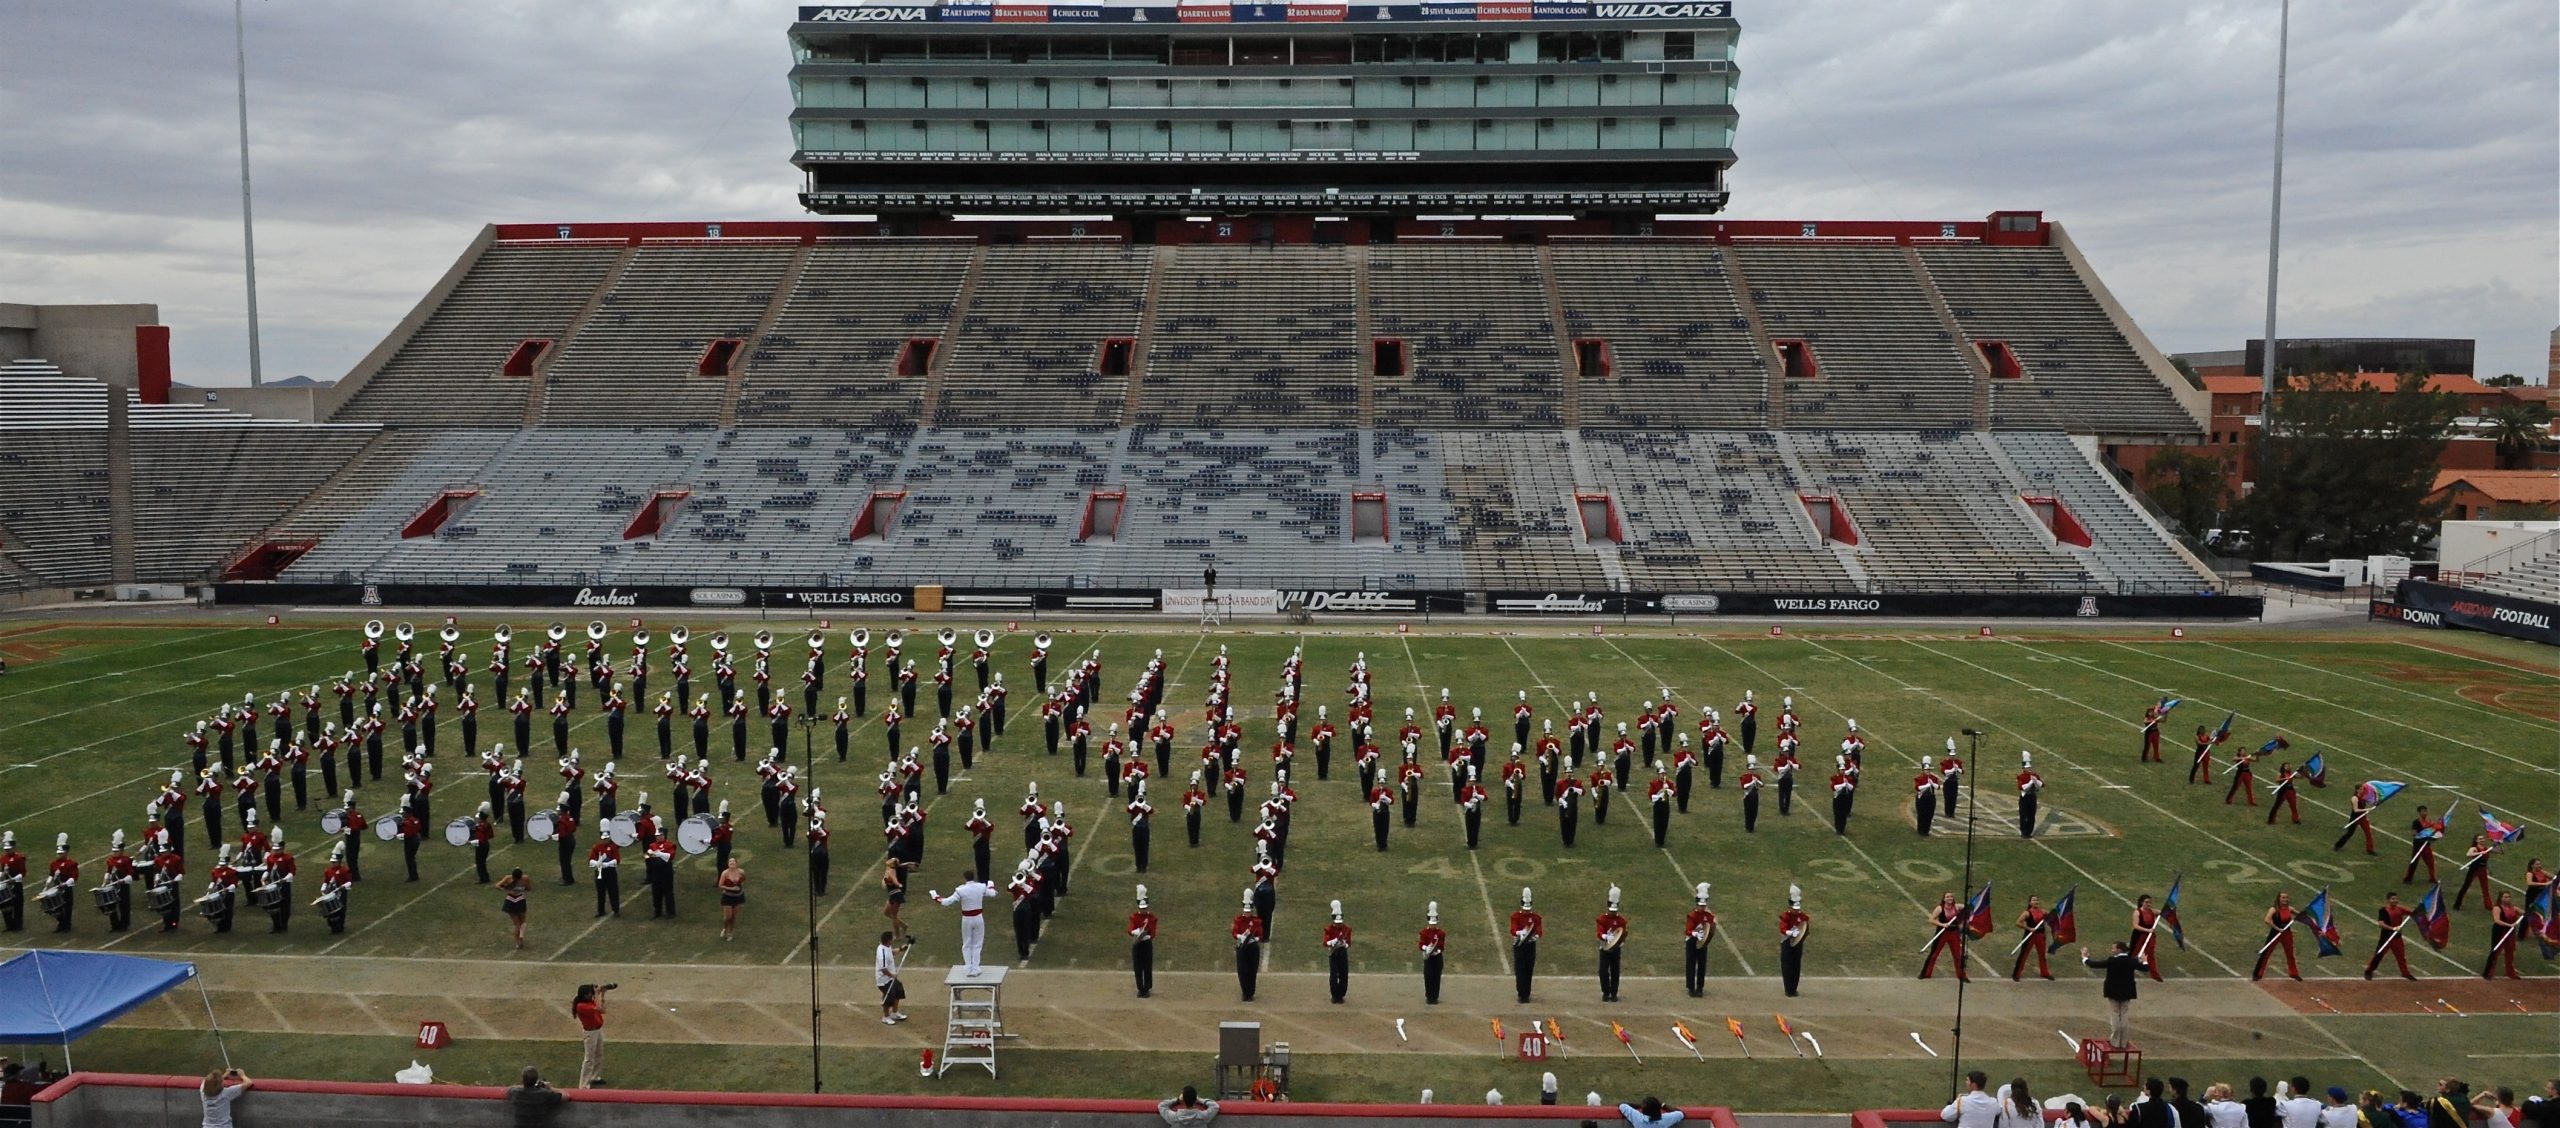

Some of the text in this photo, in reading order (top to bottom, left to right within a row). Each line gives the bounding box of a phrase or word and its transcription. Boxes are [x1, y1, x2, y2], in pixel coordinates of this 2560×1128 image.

[812, 8, 926, 21] ARIZONA
[942, 8, 949, 16] 22
[1082, 10, 1100, 18] CECIL
[1310, 8, 1340, 16] WALDROP
[1596, 4, 1724, 17] WILDCATS
[560, 230, 570, 240] 17
[708, 229, 720, 238] 18
[880, 228, 890, 237] 19
[1072, 227, 1085, 236] 20
[1220, 227, 1230, 236] 21
[1442, 227, 1454, 236] 22
[1640, 227, 1652, 236] 23
[1802, 228, 1815, 237] 24
[1942, 228, 1955, 238] 25
[207, 392, 217, 400] 16
[574, 588, 638, 605] Bashas'
[799, 593, 902, 603] WELLS FARGO
[1165, 596, 1199, 606] UNIVERSITY
[1241, 596, 1259, 606] BAND
[1261, 596, 1273, 606] DAY
[1774, 599, 1880, 610] WELLS FARGO
[2374, 604, 2440, 626] BEAR DOWN
[2451, 601, 2550, 629] ARIZONA FOOTBALL
[420, 1025, 437, 1044] 40
[1523, 1038, 1541, 1056] 40
